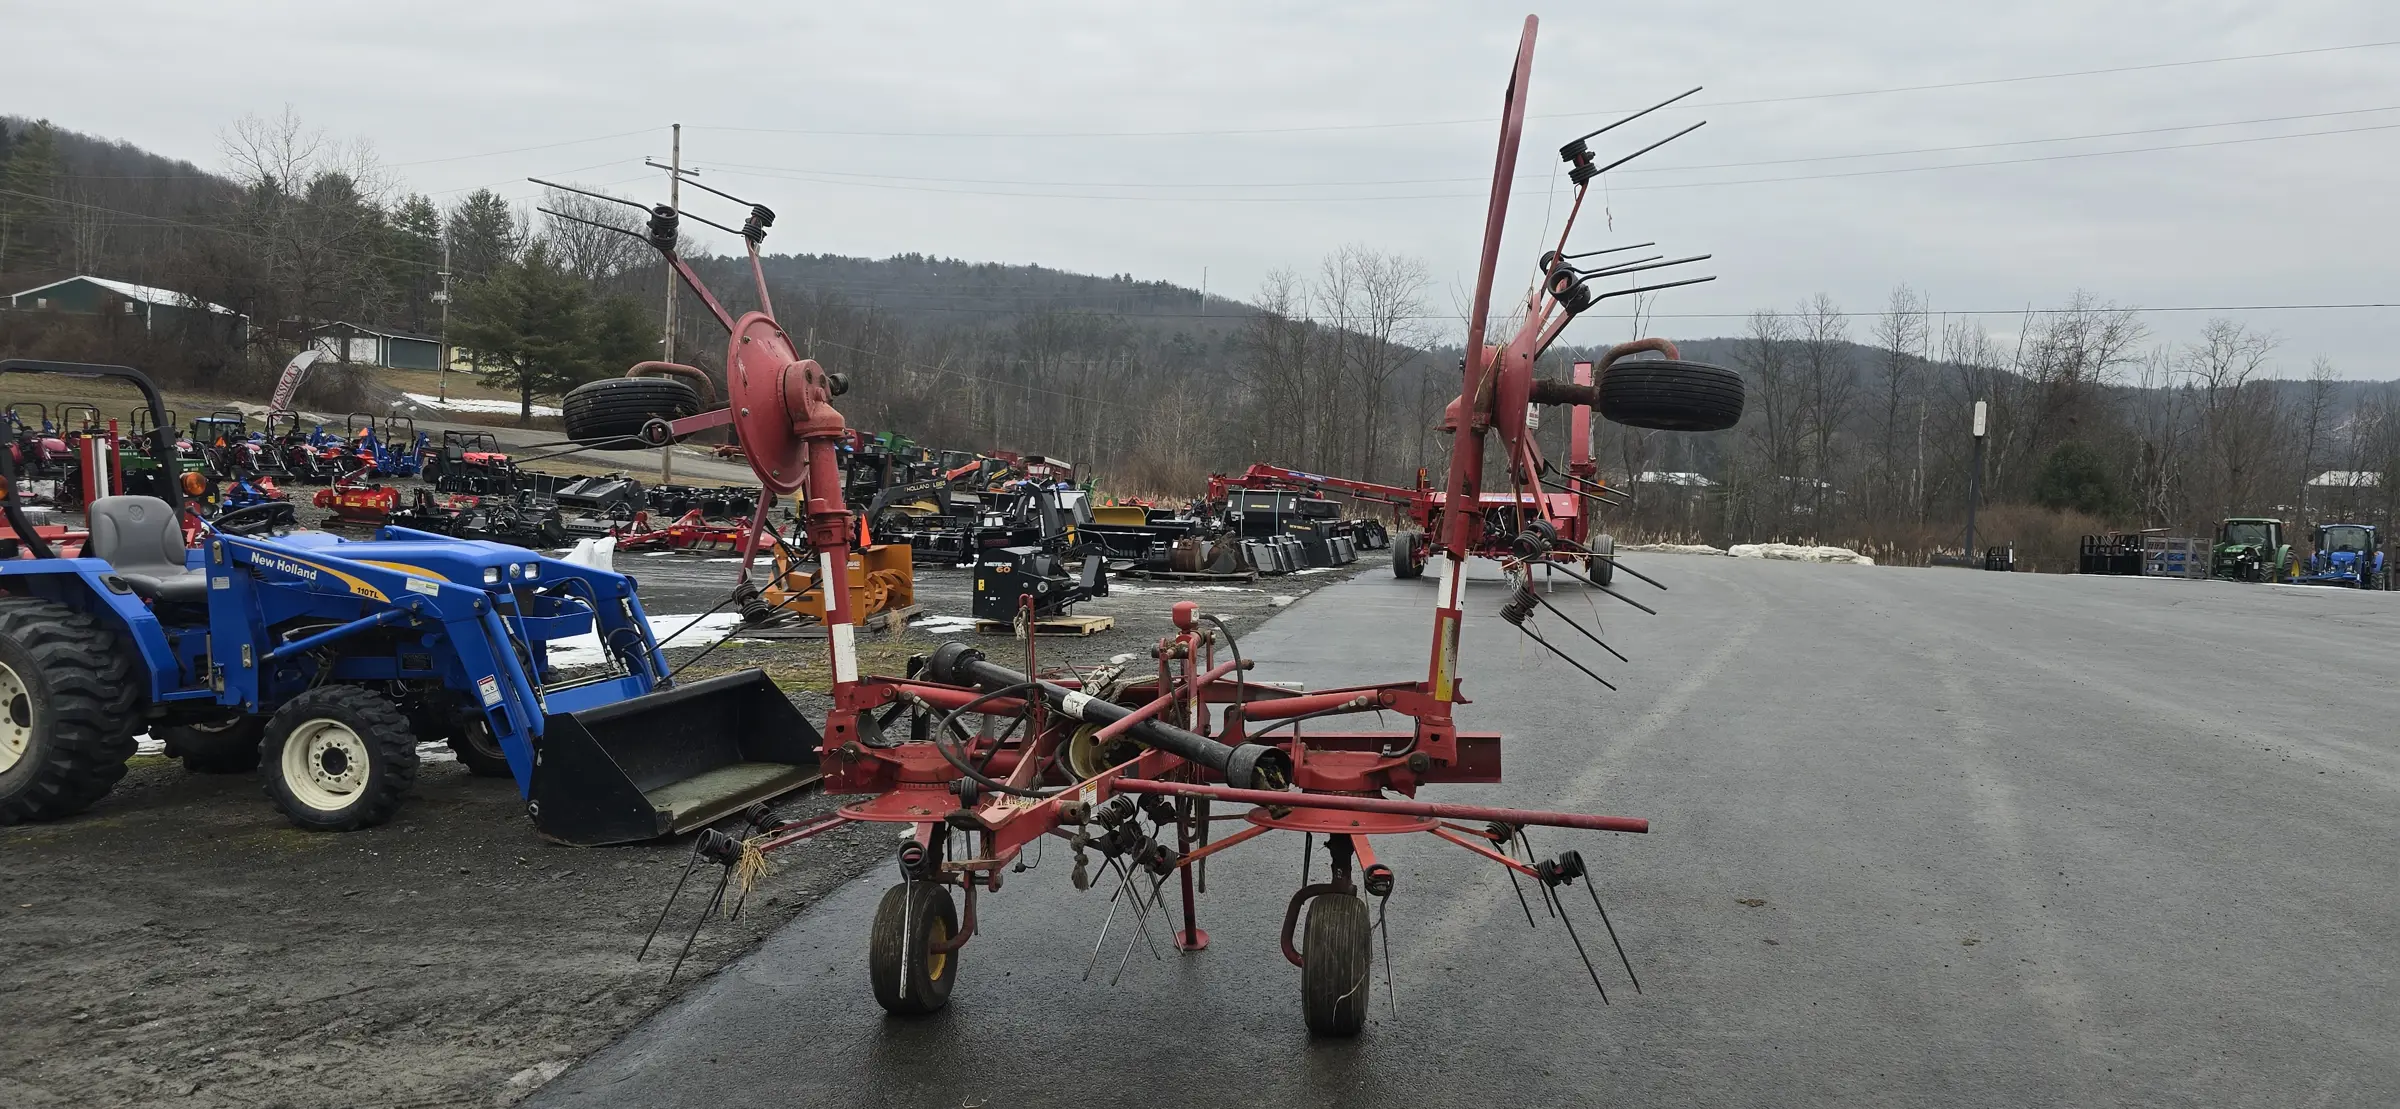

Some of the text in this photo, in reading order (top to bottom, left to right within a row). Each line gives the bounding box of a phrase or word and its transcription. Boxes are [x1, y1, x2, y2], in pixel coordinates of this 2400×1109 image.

[251, 552, 317, 581] New Holland
[356, 586, 379, 599] 110TL
